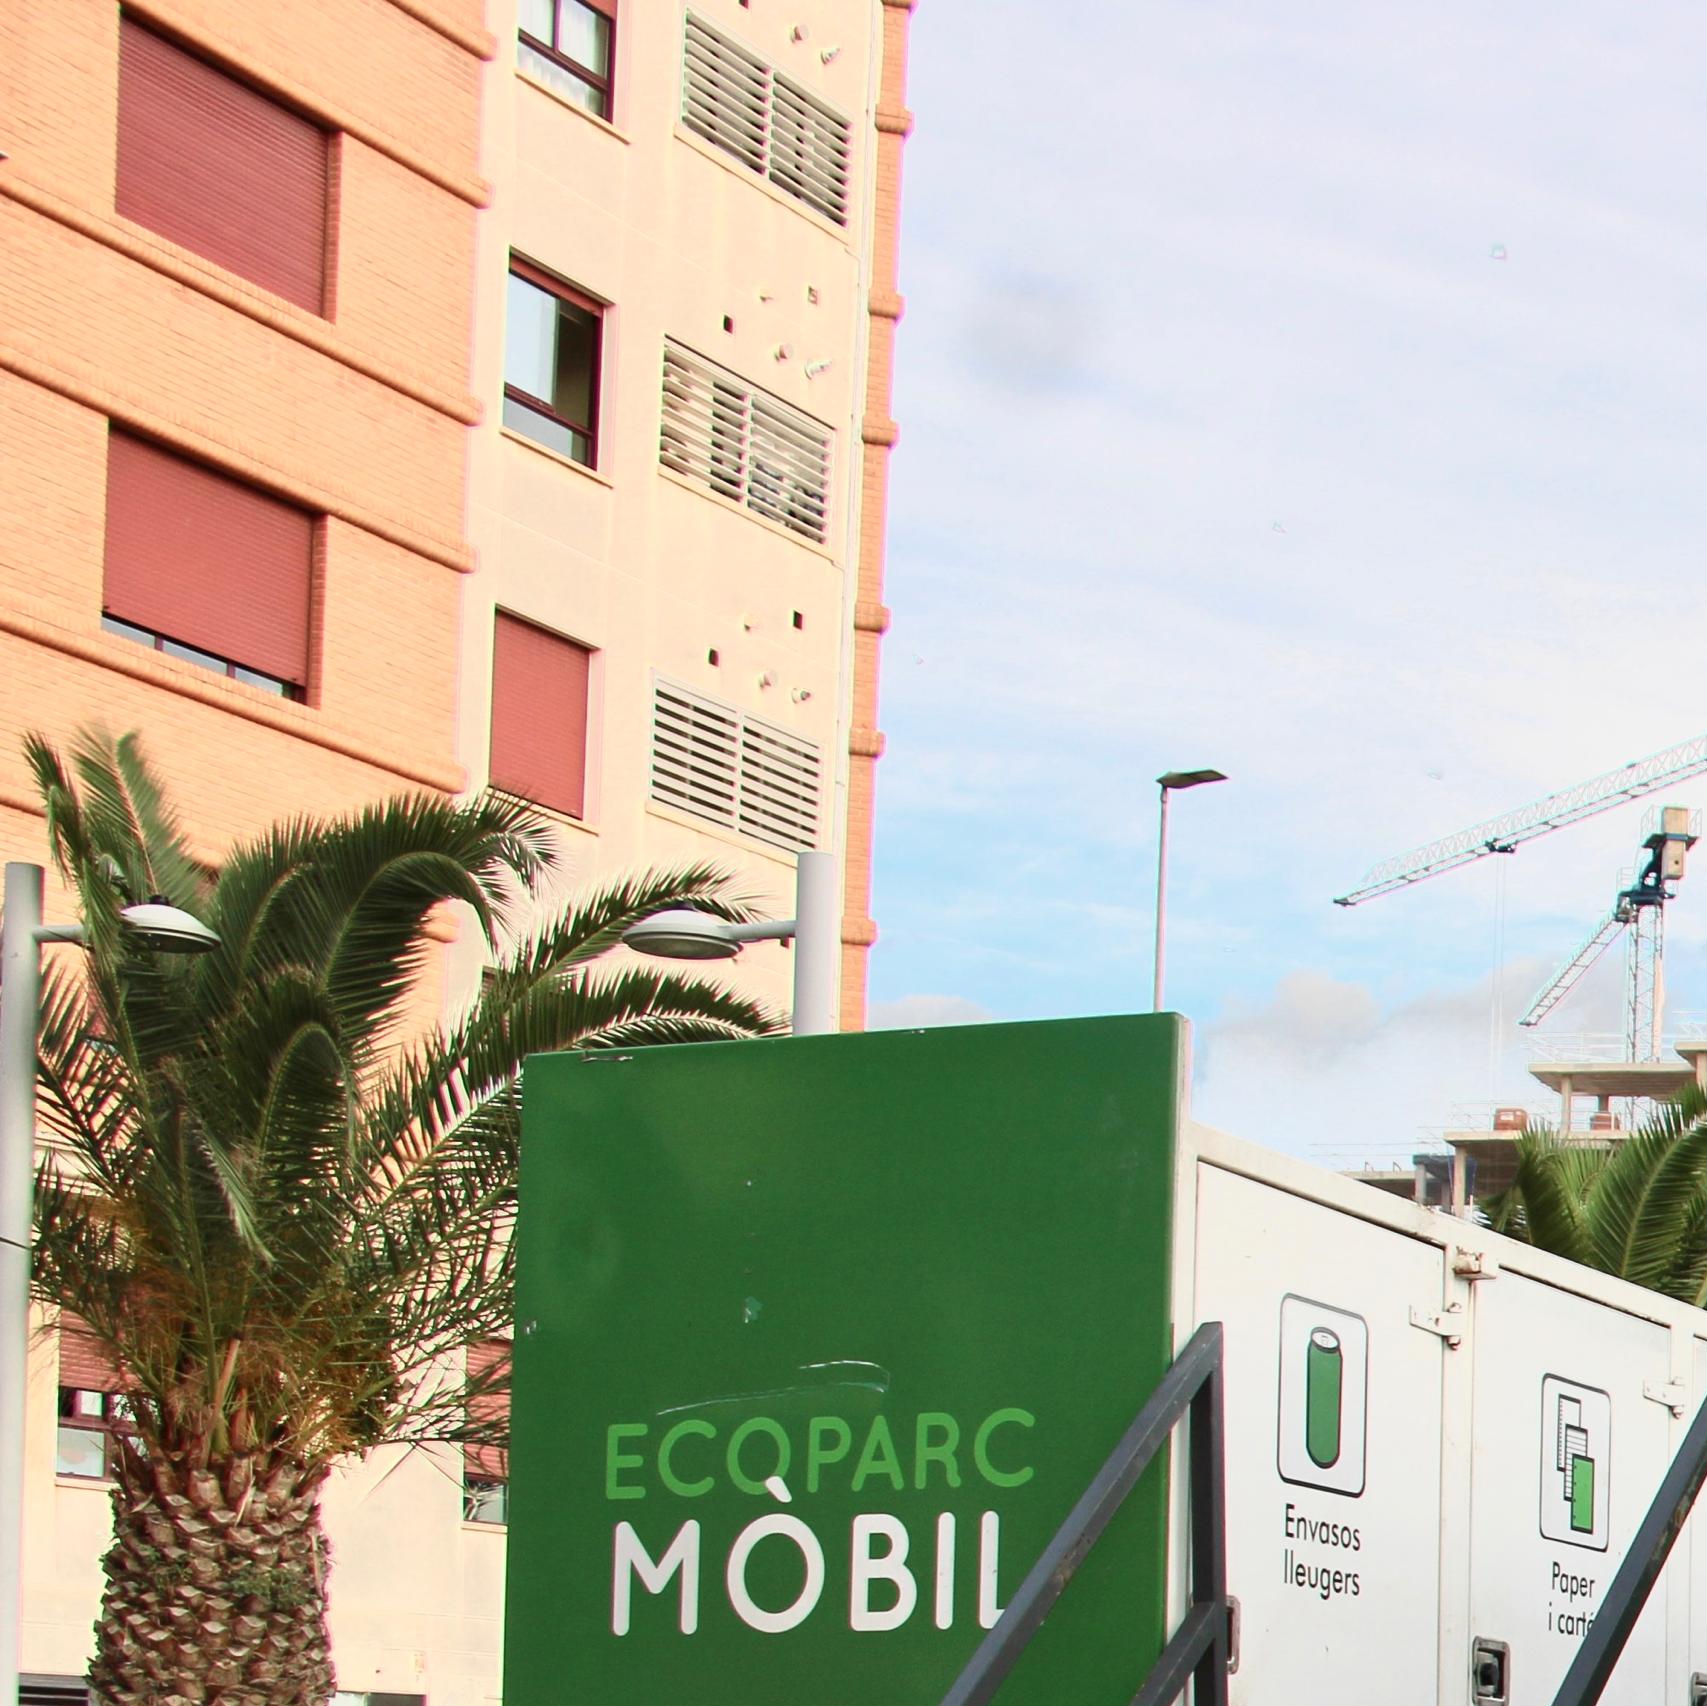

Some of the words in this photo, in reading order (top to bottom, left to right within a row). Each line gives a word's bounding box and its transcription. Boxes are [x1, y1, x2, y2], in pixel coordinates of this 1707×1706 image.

[606, 1407, 1035, 1499] ECOPARC
[1285, 1503, 1361, 1551] Envasos
[613, 1476, 1006, 1636] MÒBIL
[1284, 1549, 1360, 1600] lleugers
[1552, 1561, 1595, 1602] Paper
[1548, 1601, 1552, 1631] i
